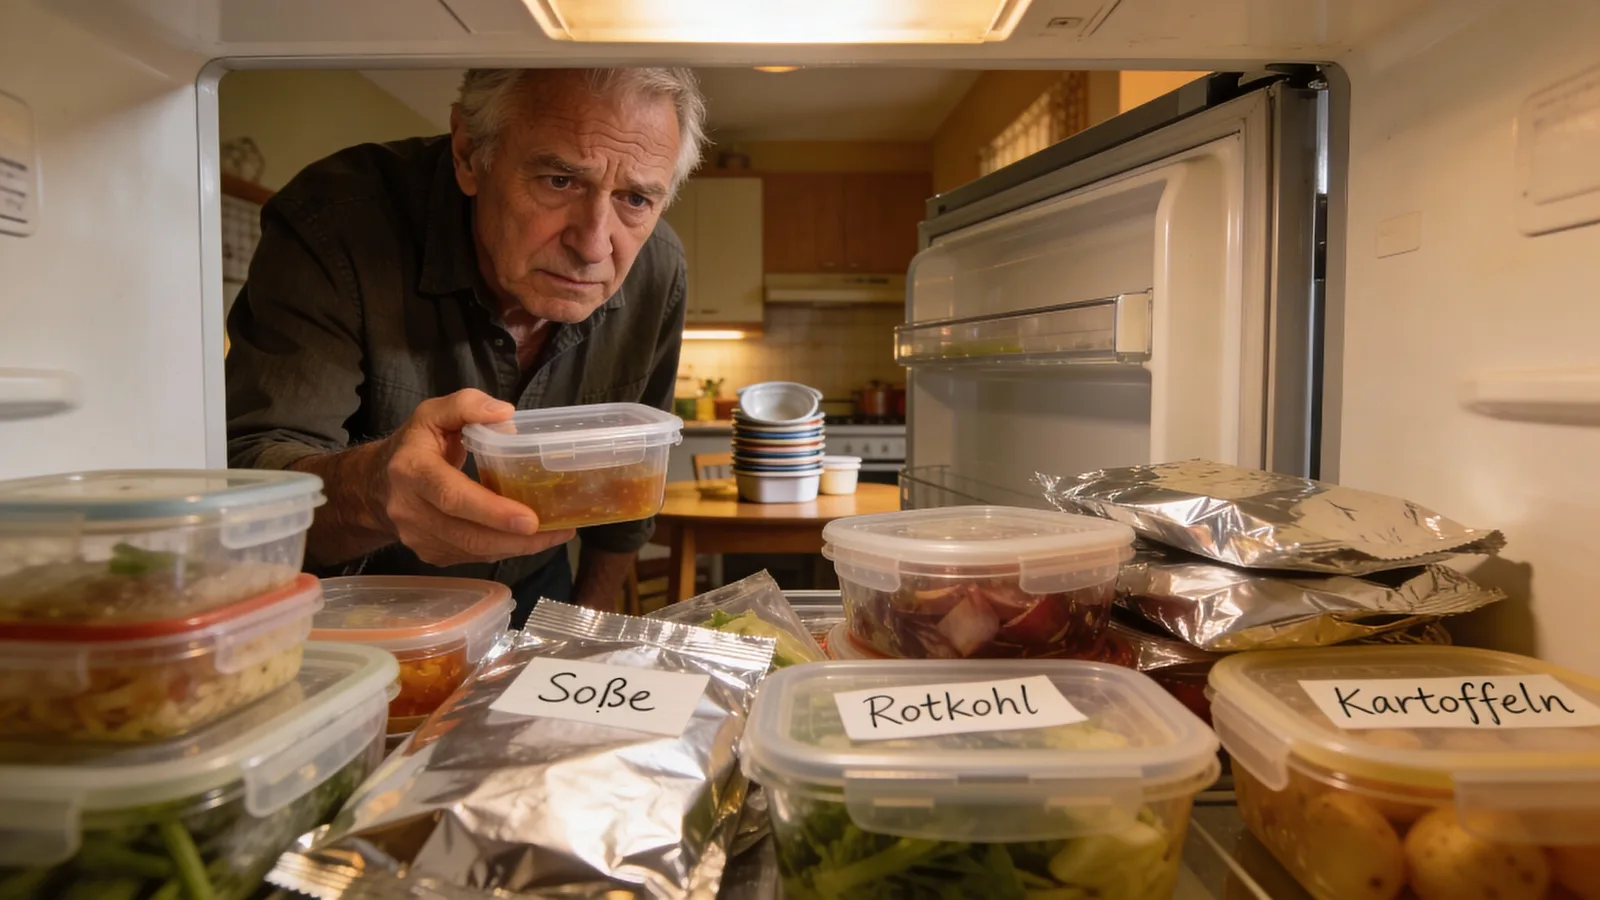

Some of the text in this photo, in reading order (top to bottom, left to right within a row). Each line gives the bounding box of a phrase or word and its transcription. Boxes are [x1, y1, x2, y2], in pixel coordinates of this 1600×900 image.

[537, 672, 656, 713] Soße
[863, 683, 1040, 729] Rotkohl
[1333, 681, 1576, 726] Kartoffeln
